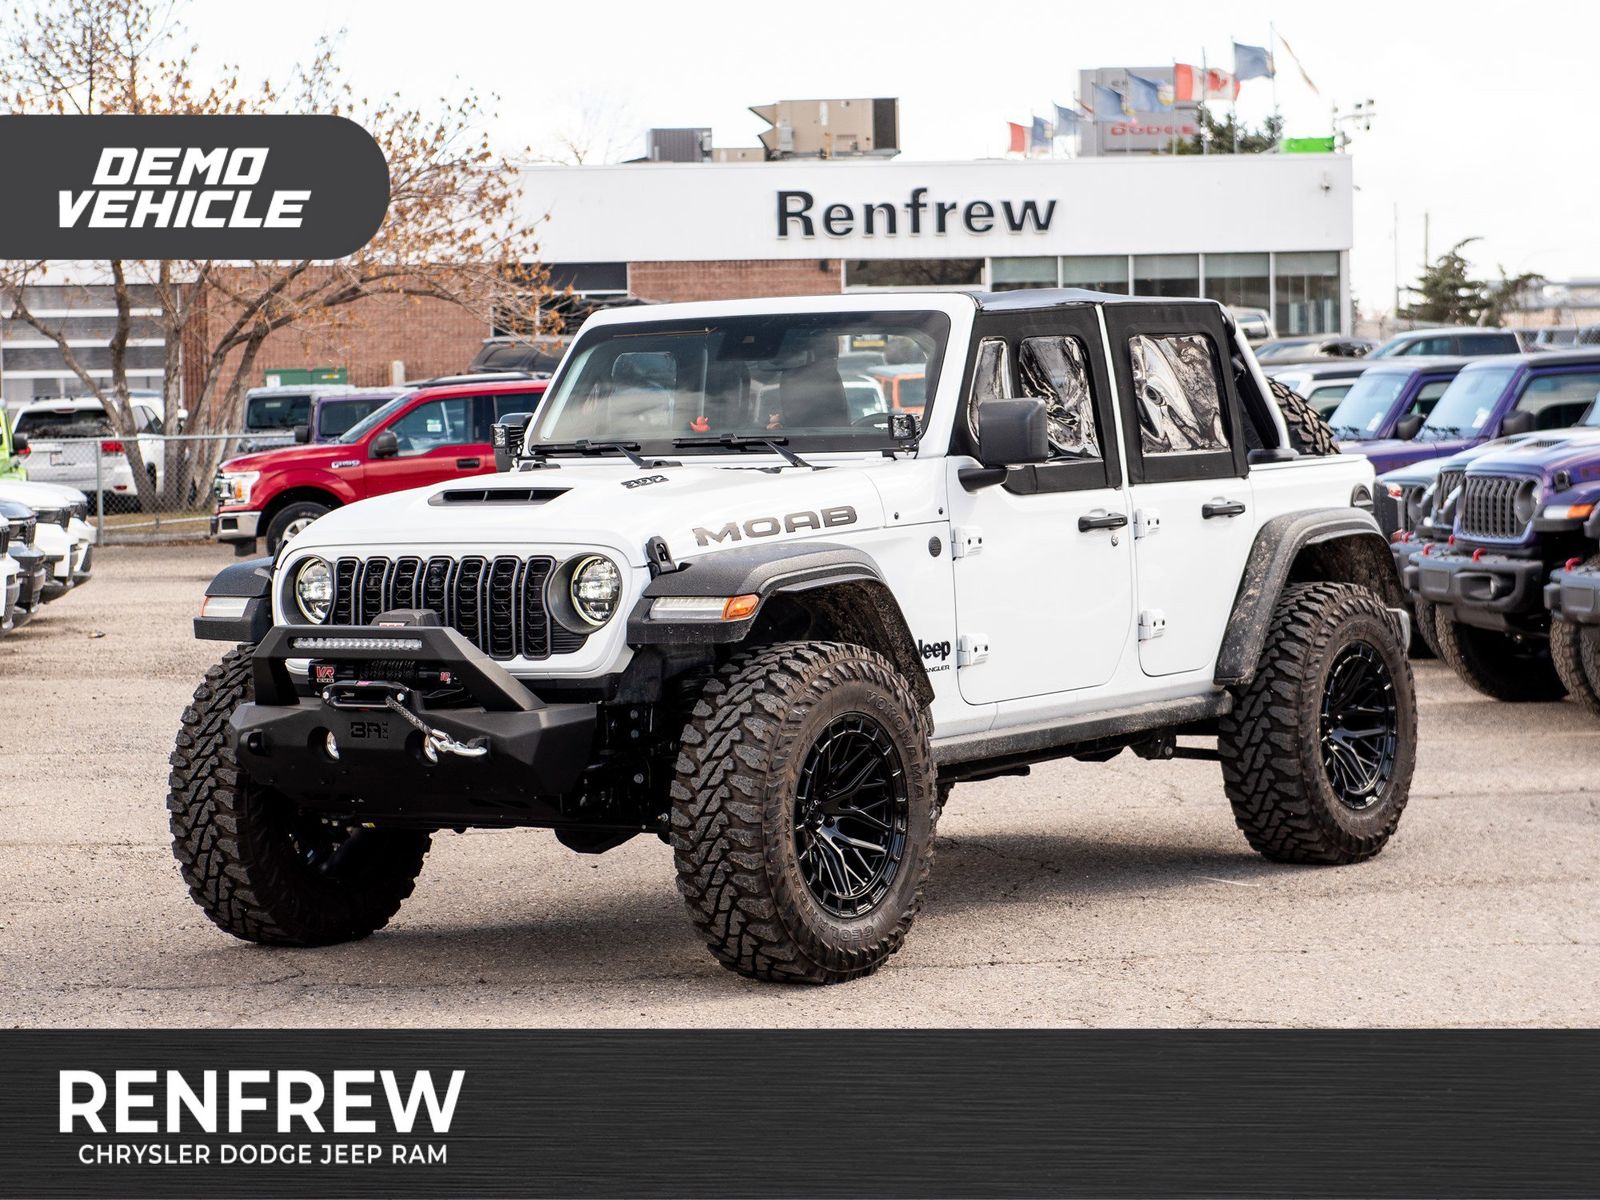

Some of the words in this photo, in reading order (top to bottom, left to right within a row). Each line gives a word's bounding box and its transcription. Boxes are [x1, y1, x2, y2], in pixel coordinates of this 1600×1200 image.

[776, 187, 1057, 238] Renfrew
[692, 505, 858, 548] MOAB
[866, 688, 925, 801] YOKOHAMA
